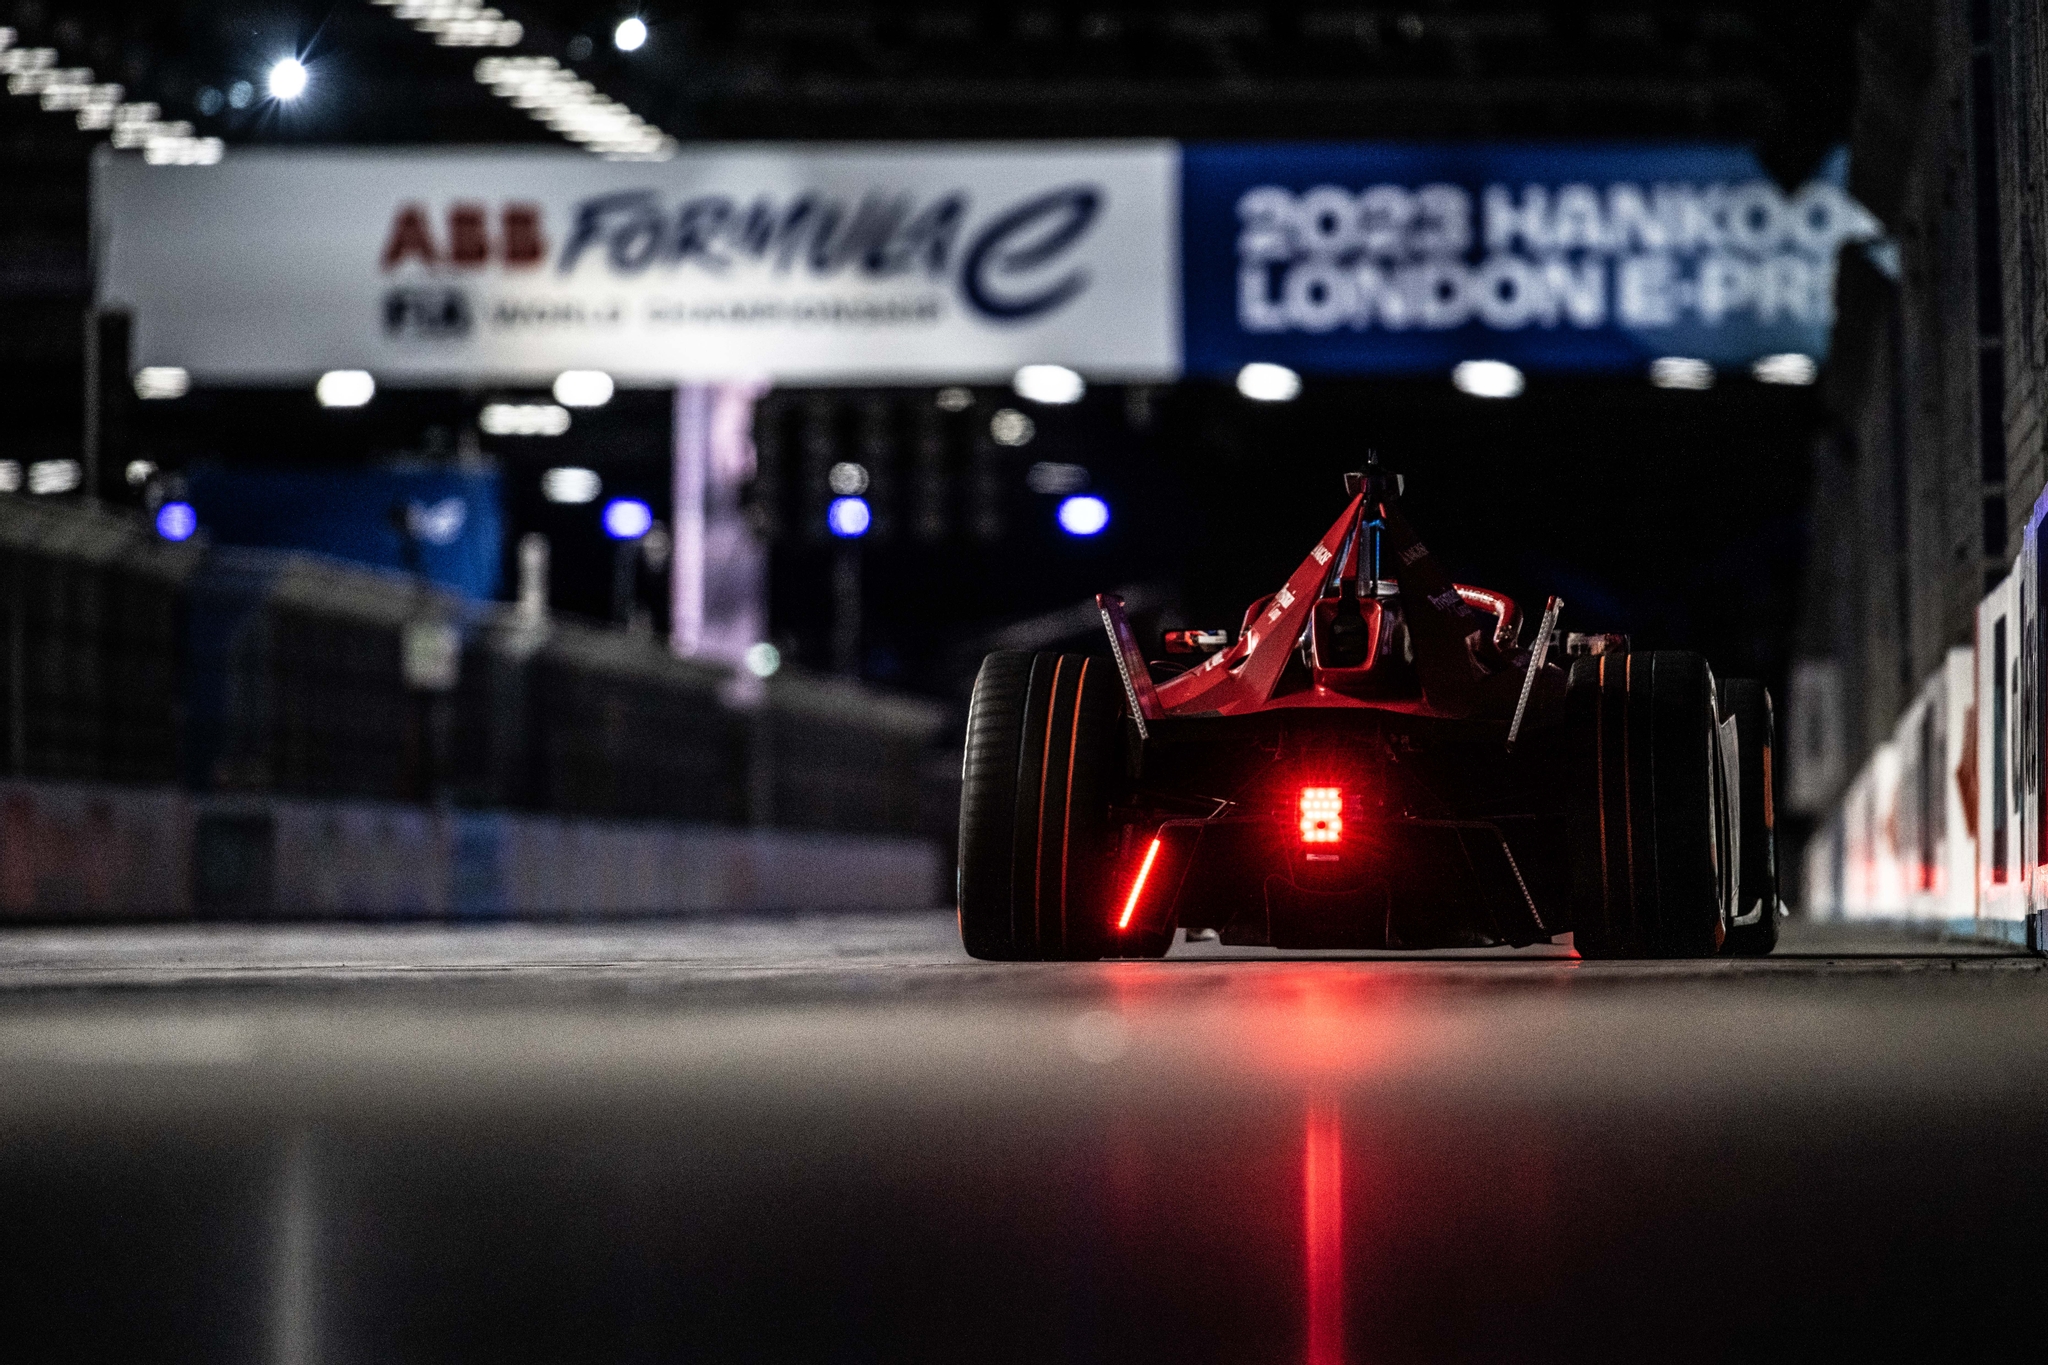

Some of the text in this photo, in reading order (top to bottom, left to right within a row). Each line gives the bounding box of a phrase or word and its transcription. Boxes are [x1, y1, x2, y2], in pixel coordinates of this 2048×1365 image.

[380, 205, 542, 270] ABB
[556, 188, 964, 280] FORMULA
[1235, 183, 1884, 254] 2023 HANKOO
[382, 291, 471, 341] FIA
[1237, 254, 1606, 330] LONDON
